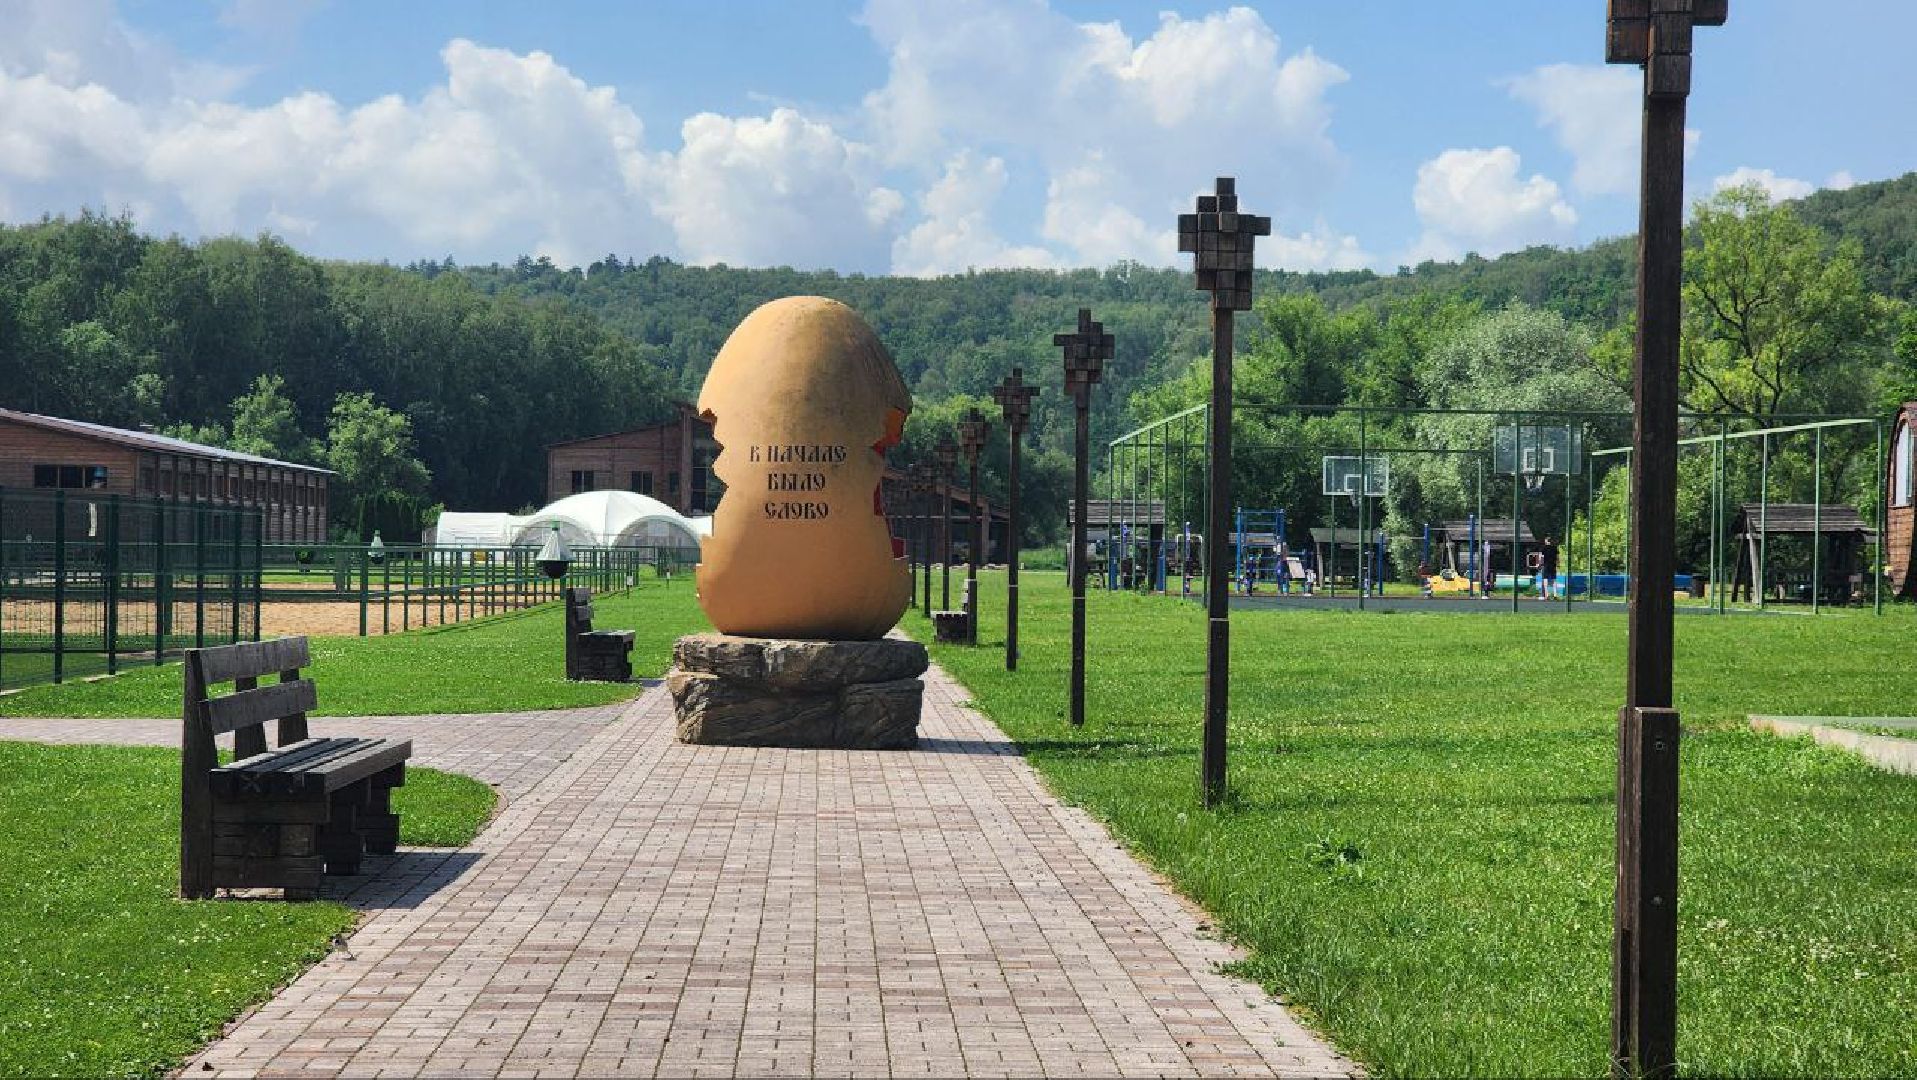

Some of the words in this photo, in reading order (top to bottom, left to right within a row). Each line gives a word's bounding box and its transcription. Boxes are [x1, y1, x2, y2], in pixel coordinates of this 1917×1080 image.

[750, 445, 760, 462] В
[768, 473, 826, 490] БЫЛО
[764, 502, 829, 519] СЛОВО
